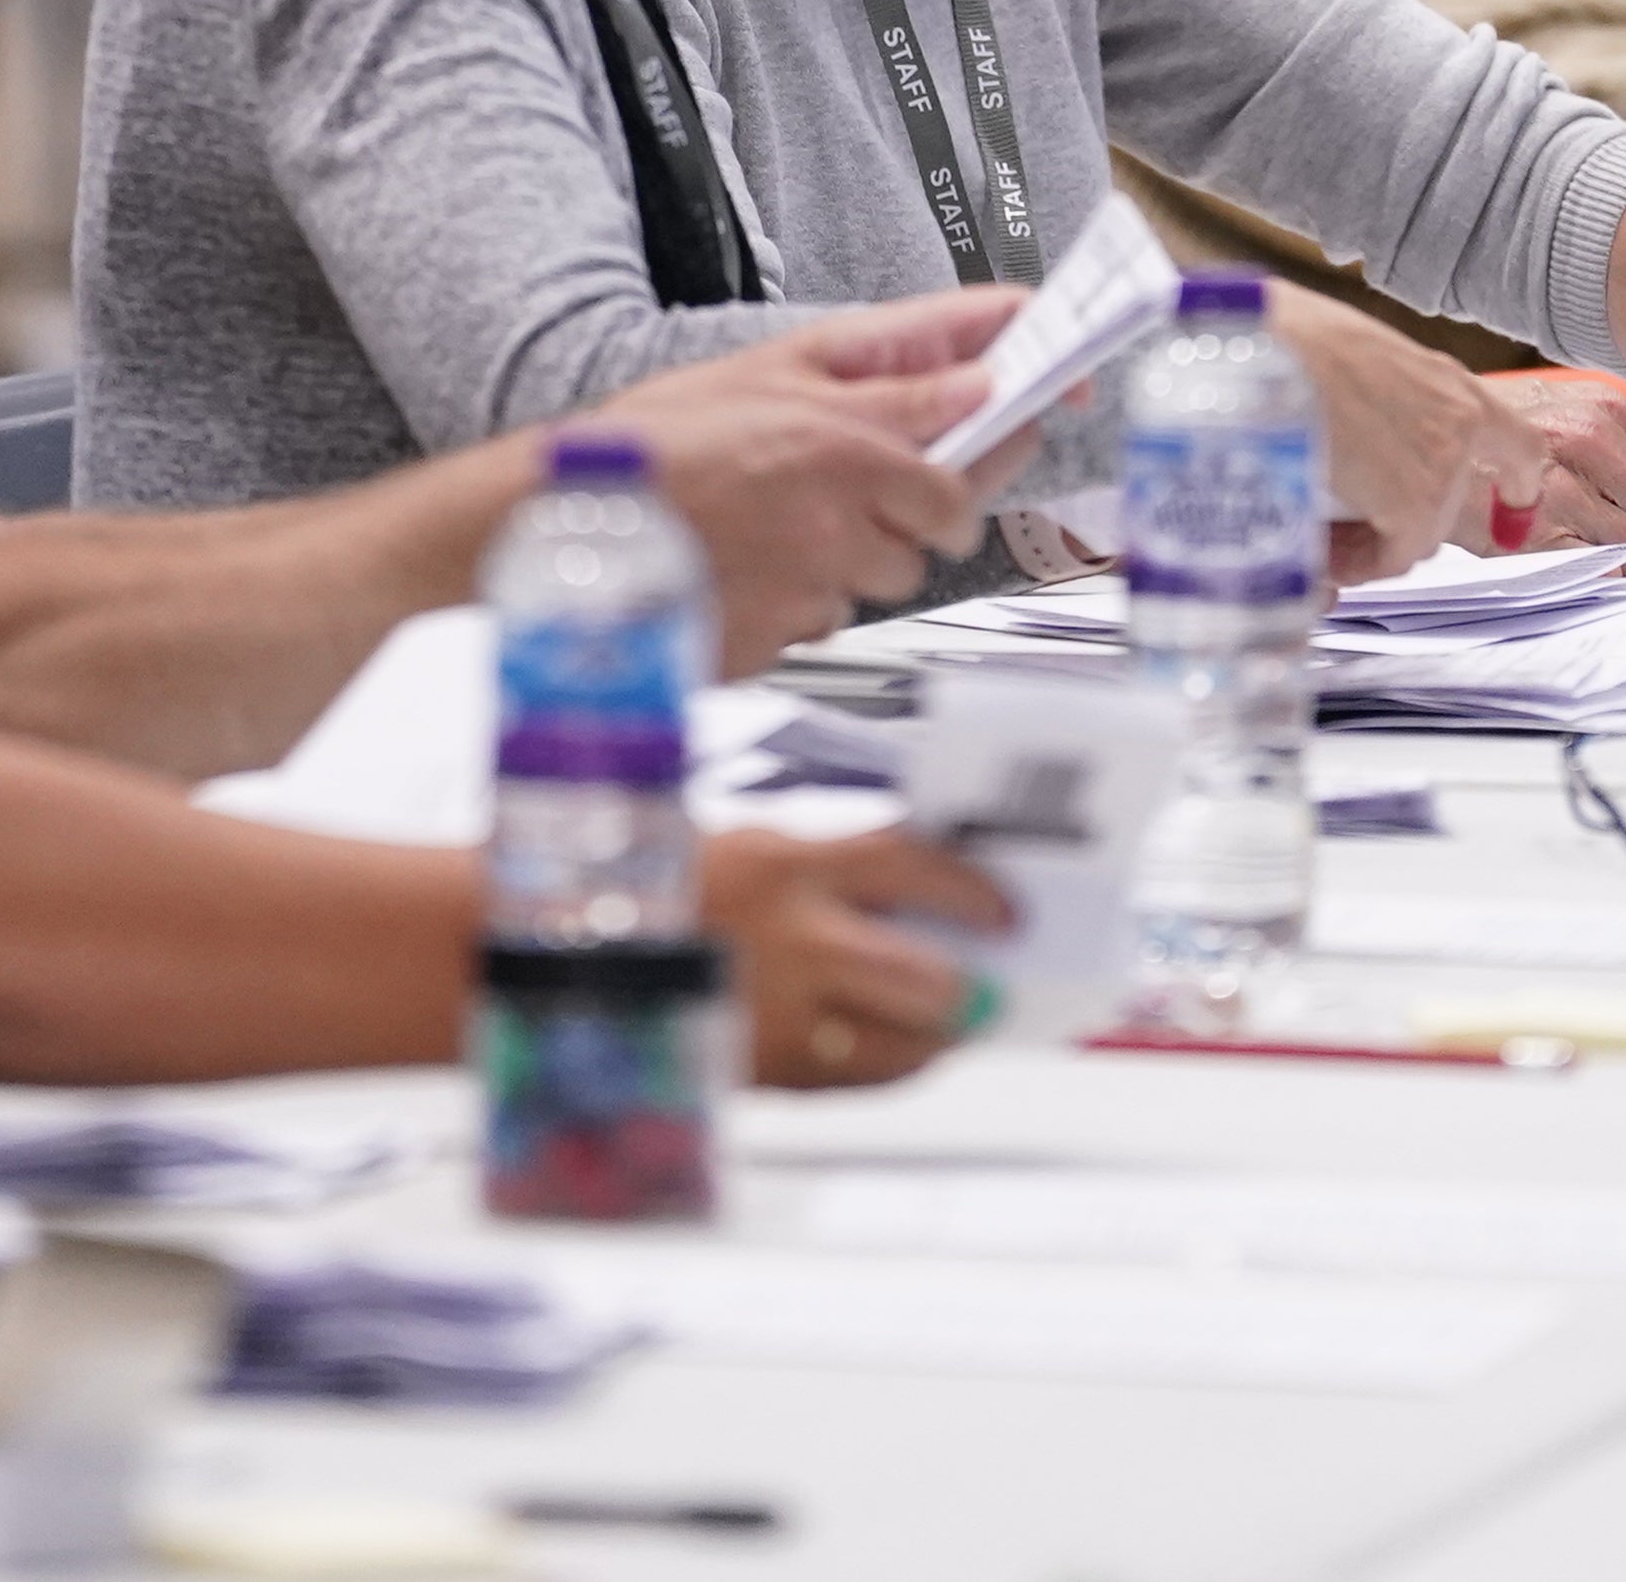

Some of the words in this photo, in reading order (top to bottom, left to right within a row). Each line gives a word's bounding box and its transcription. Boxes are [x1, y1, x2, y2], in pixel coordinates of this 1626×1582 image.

[637, 54, 689, 148] STAFF
[883, 26, 933, 114] STAFF
[967, 26, 1004, 110] STAFF
[929, 166, 975, 254] STAFF
[994, 161, 1032, 239] STAFF
